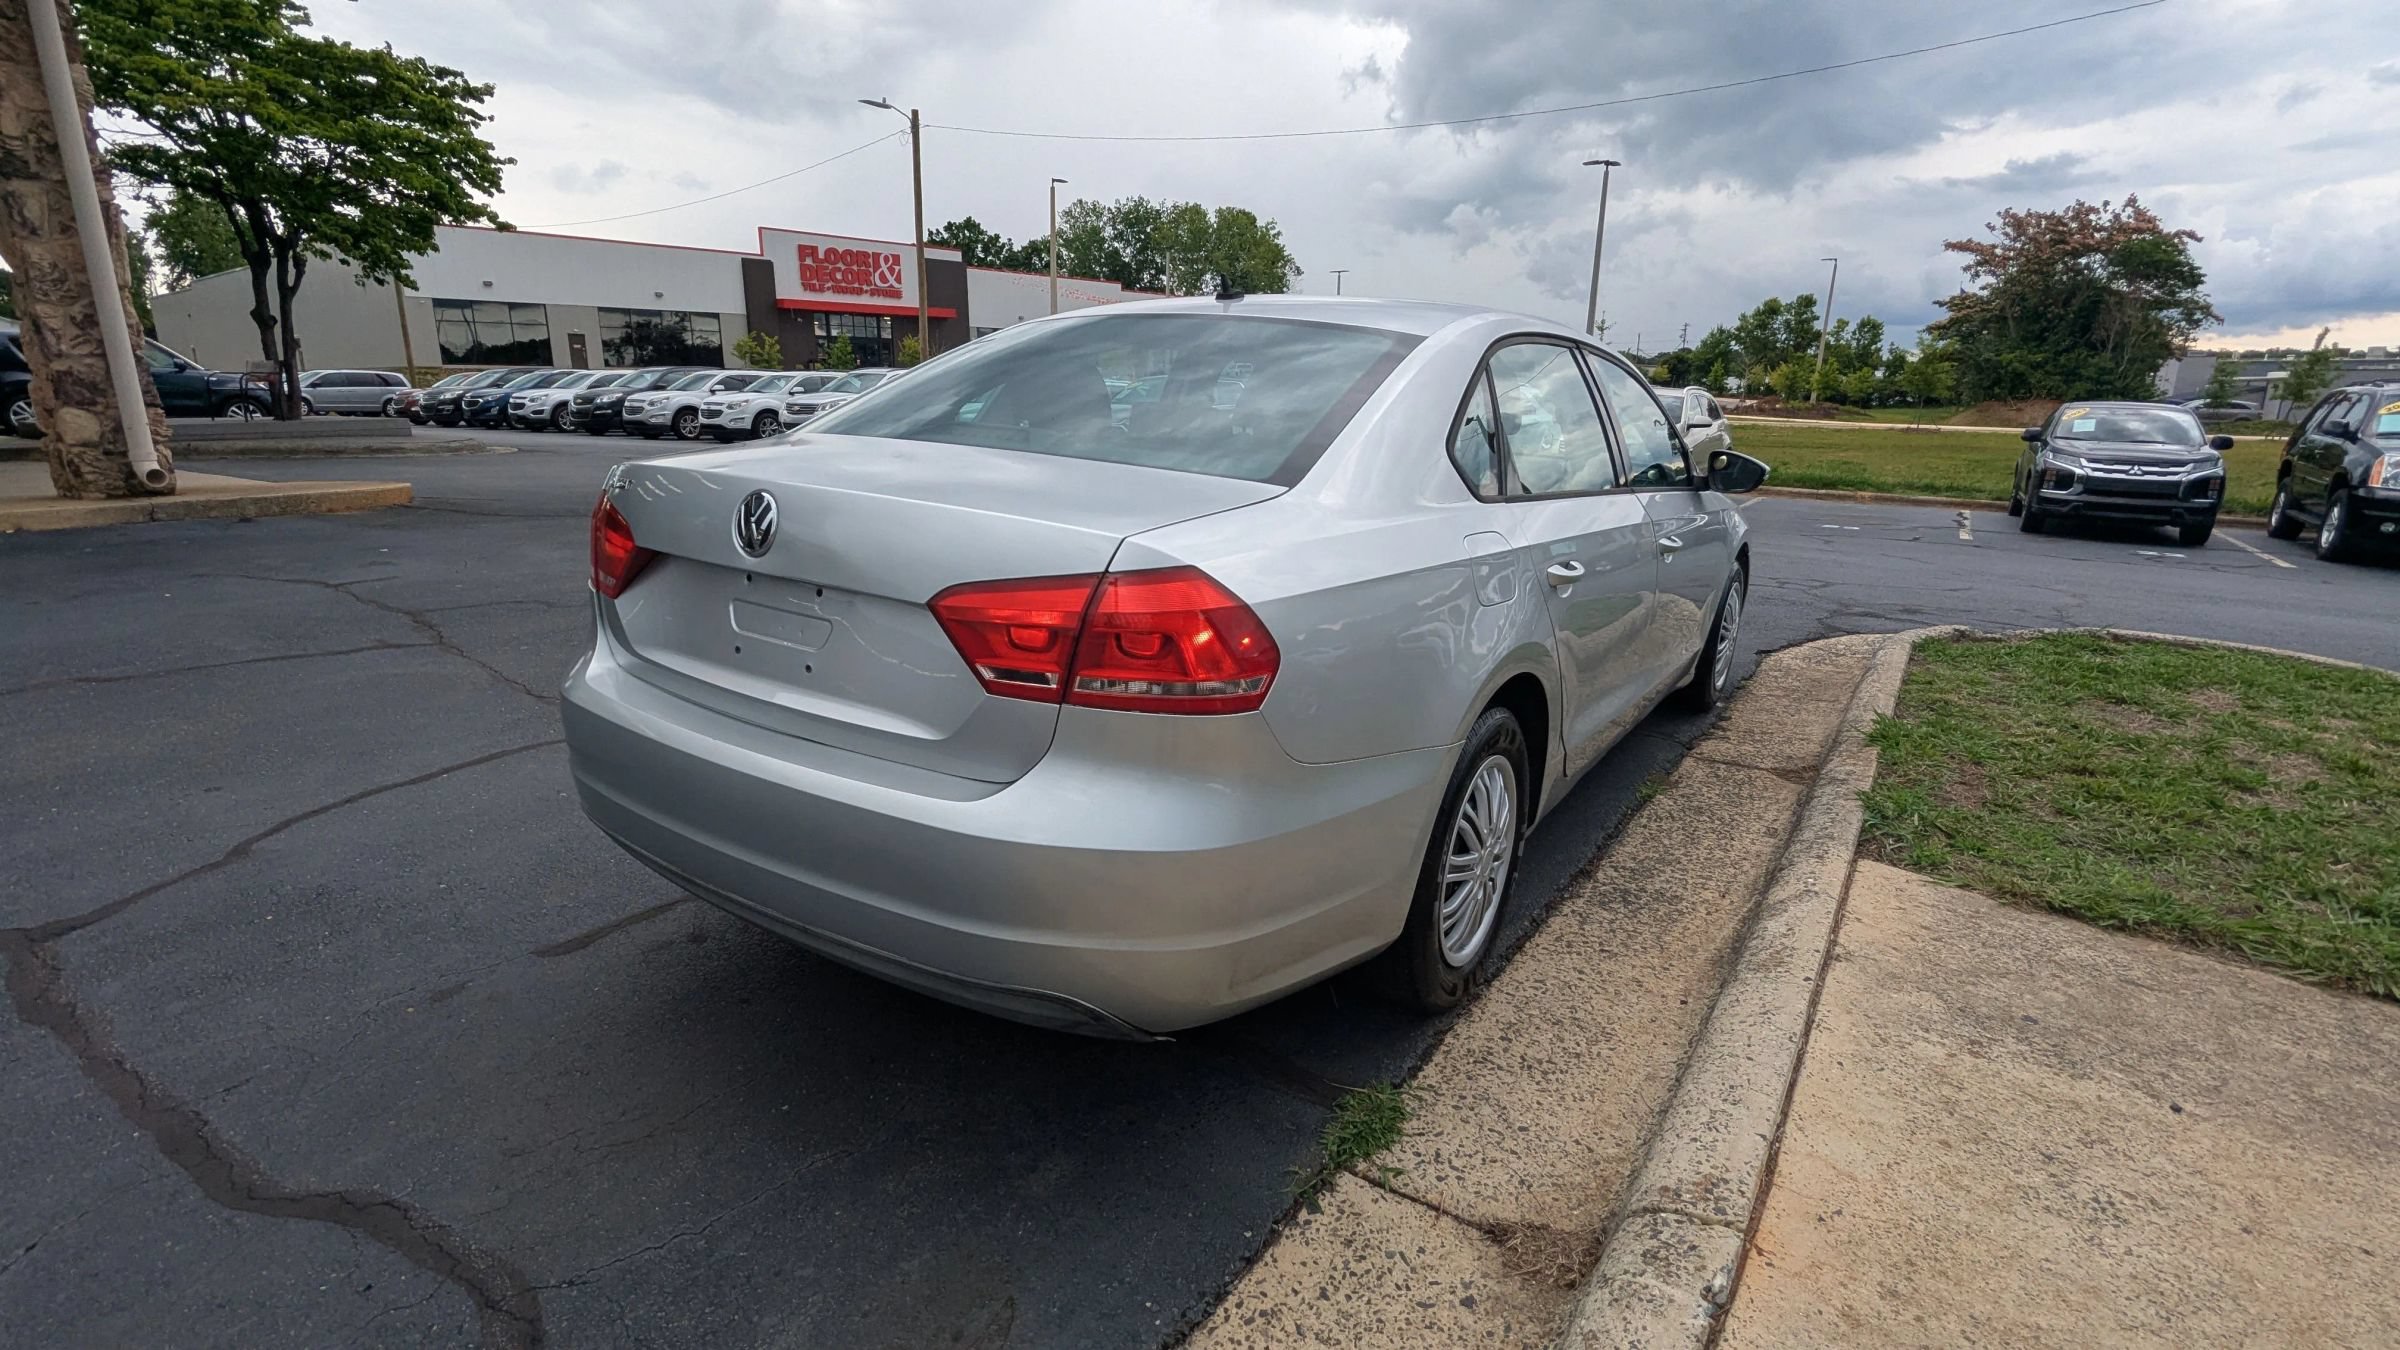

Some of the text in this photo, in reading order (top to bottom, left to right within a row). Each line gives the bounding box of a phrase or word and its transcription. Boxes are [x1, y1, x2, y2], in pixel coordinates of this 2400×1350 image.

[798, 244, 871, 268] FLOOR
[800, 264, 873, 286] DECOR
[874, 252, 902, 288] &
